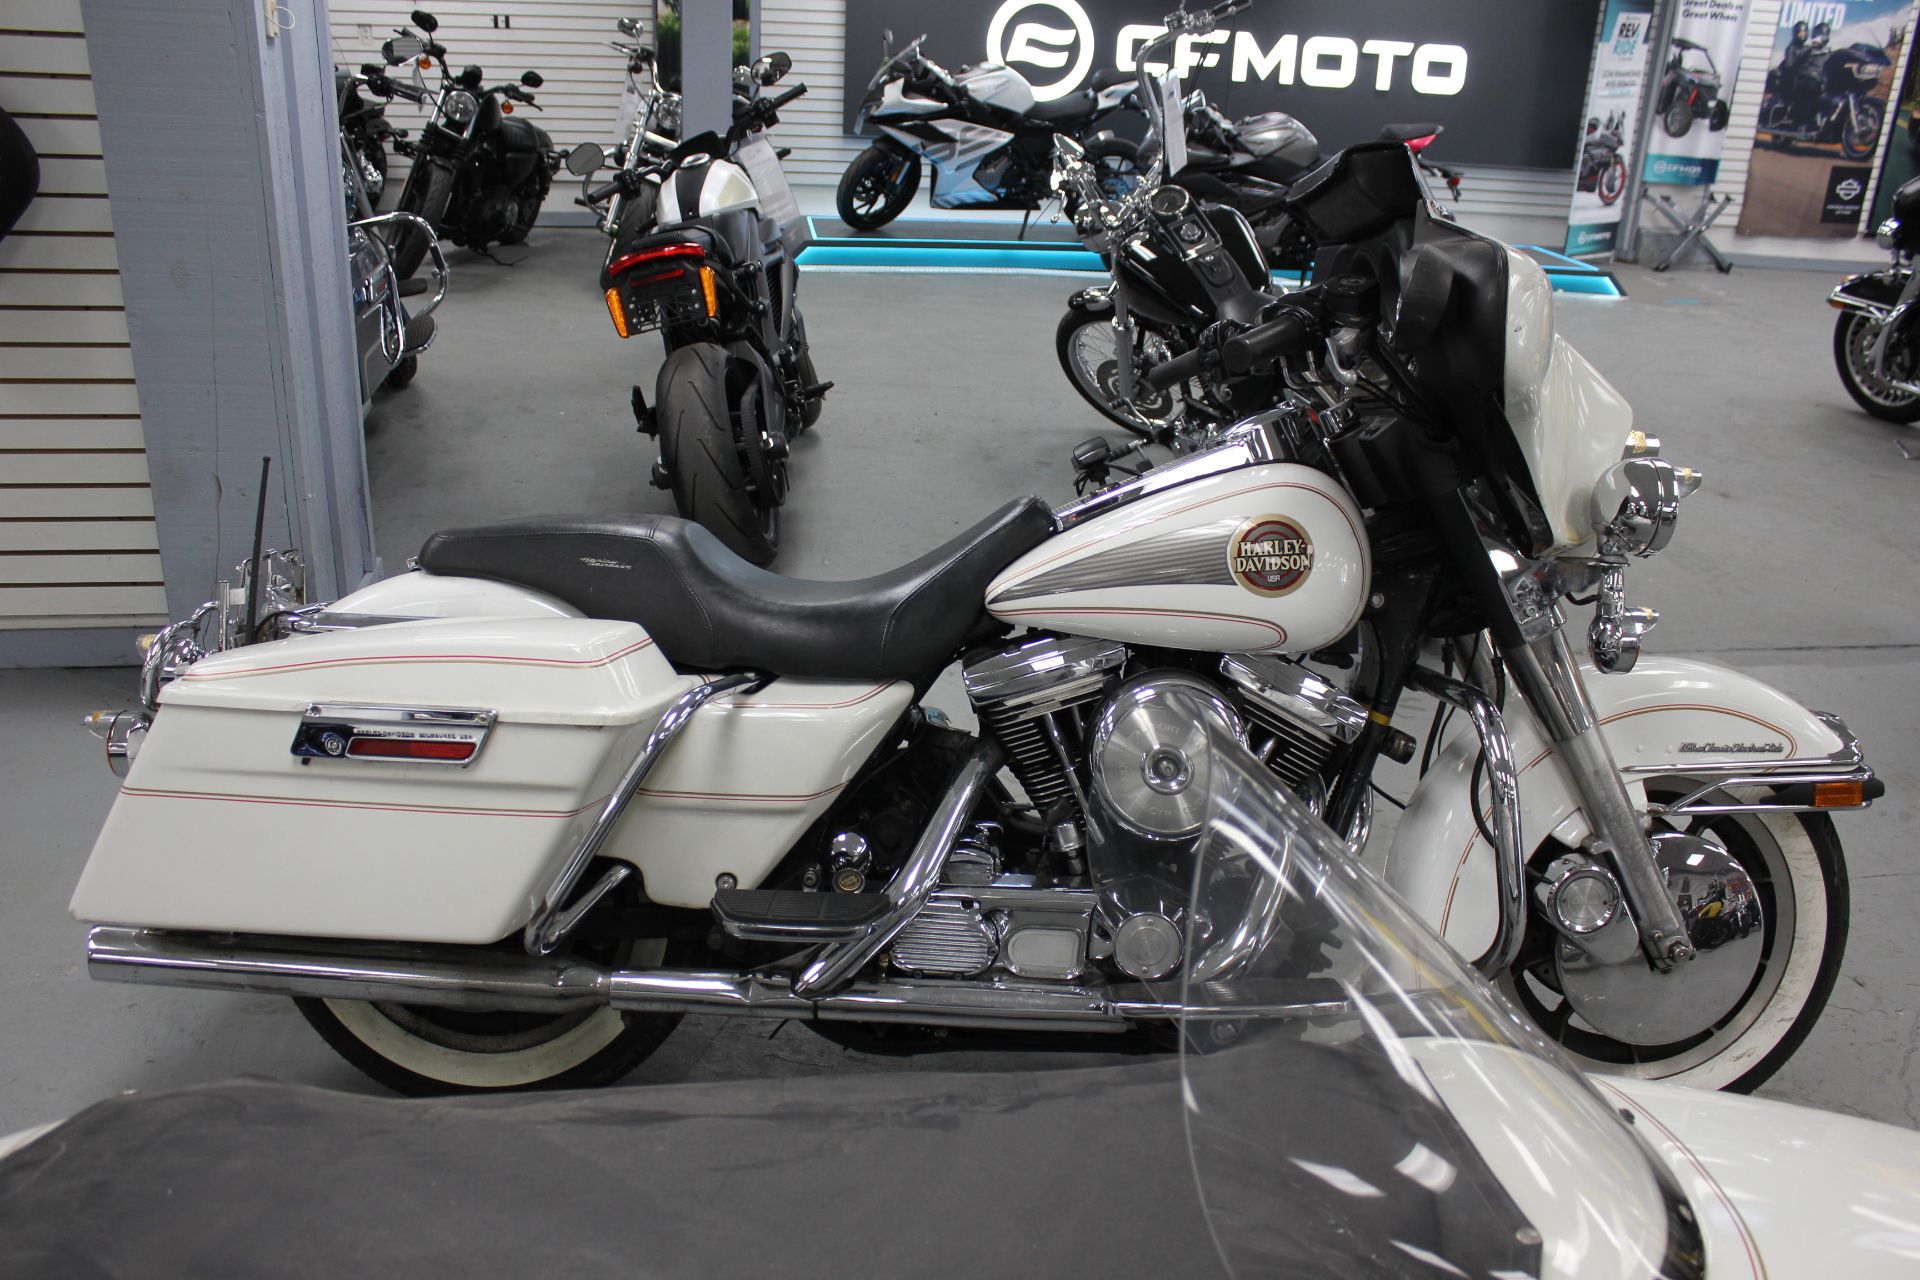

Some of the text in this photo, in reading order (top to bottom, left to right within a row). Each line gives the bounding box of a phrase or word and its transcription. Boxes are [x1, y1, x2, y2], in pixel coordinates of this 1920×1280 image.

[1682, 9, 1708, 18] Great
[1780, 1, 1846, 30] LIMITED
[1618, 22, 1640, 38] REV
[1116, 24, 1468, 96] CFMOTO
[1239, 539, 1305, 557] HARLEY-
[1234, 554, 1312, 573] DAVIDSON
[356, 729, 415, 738] HARLEY-DAVIDSON
[418, 732, 457, 740] MILWAUKEE
